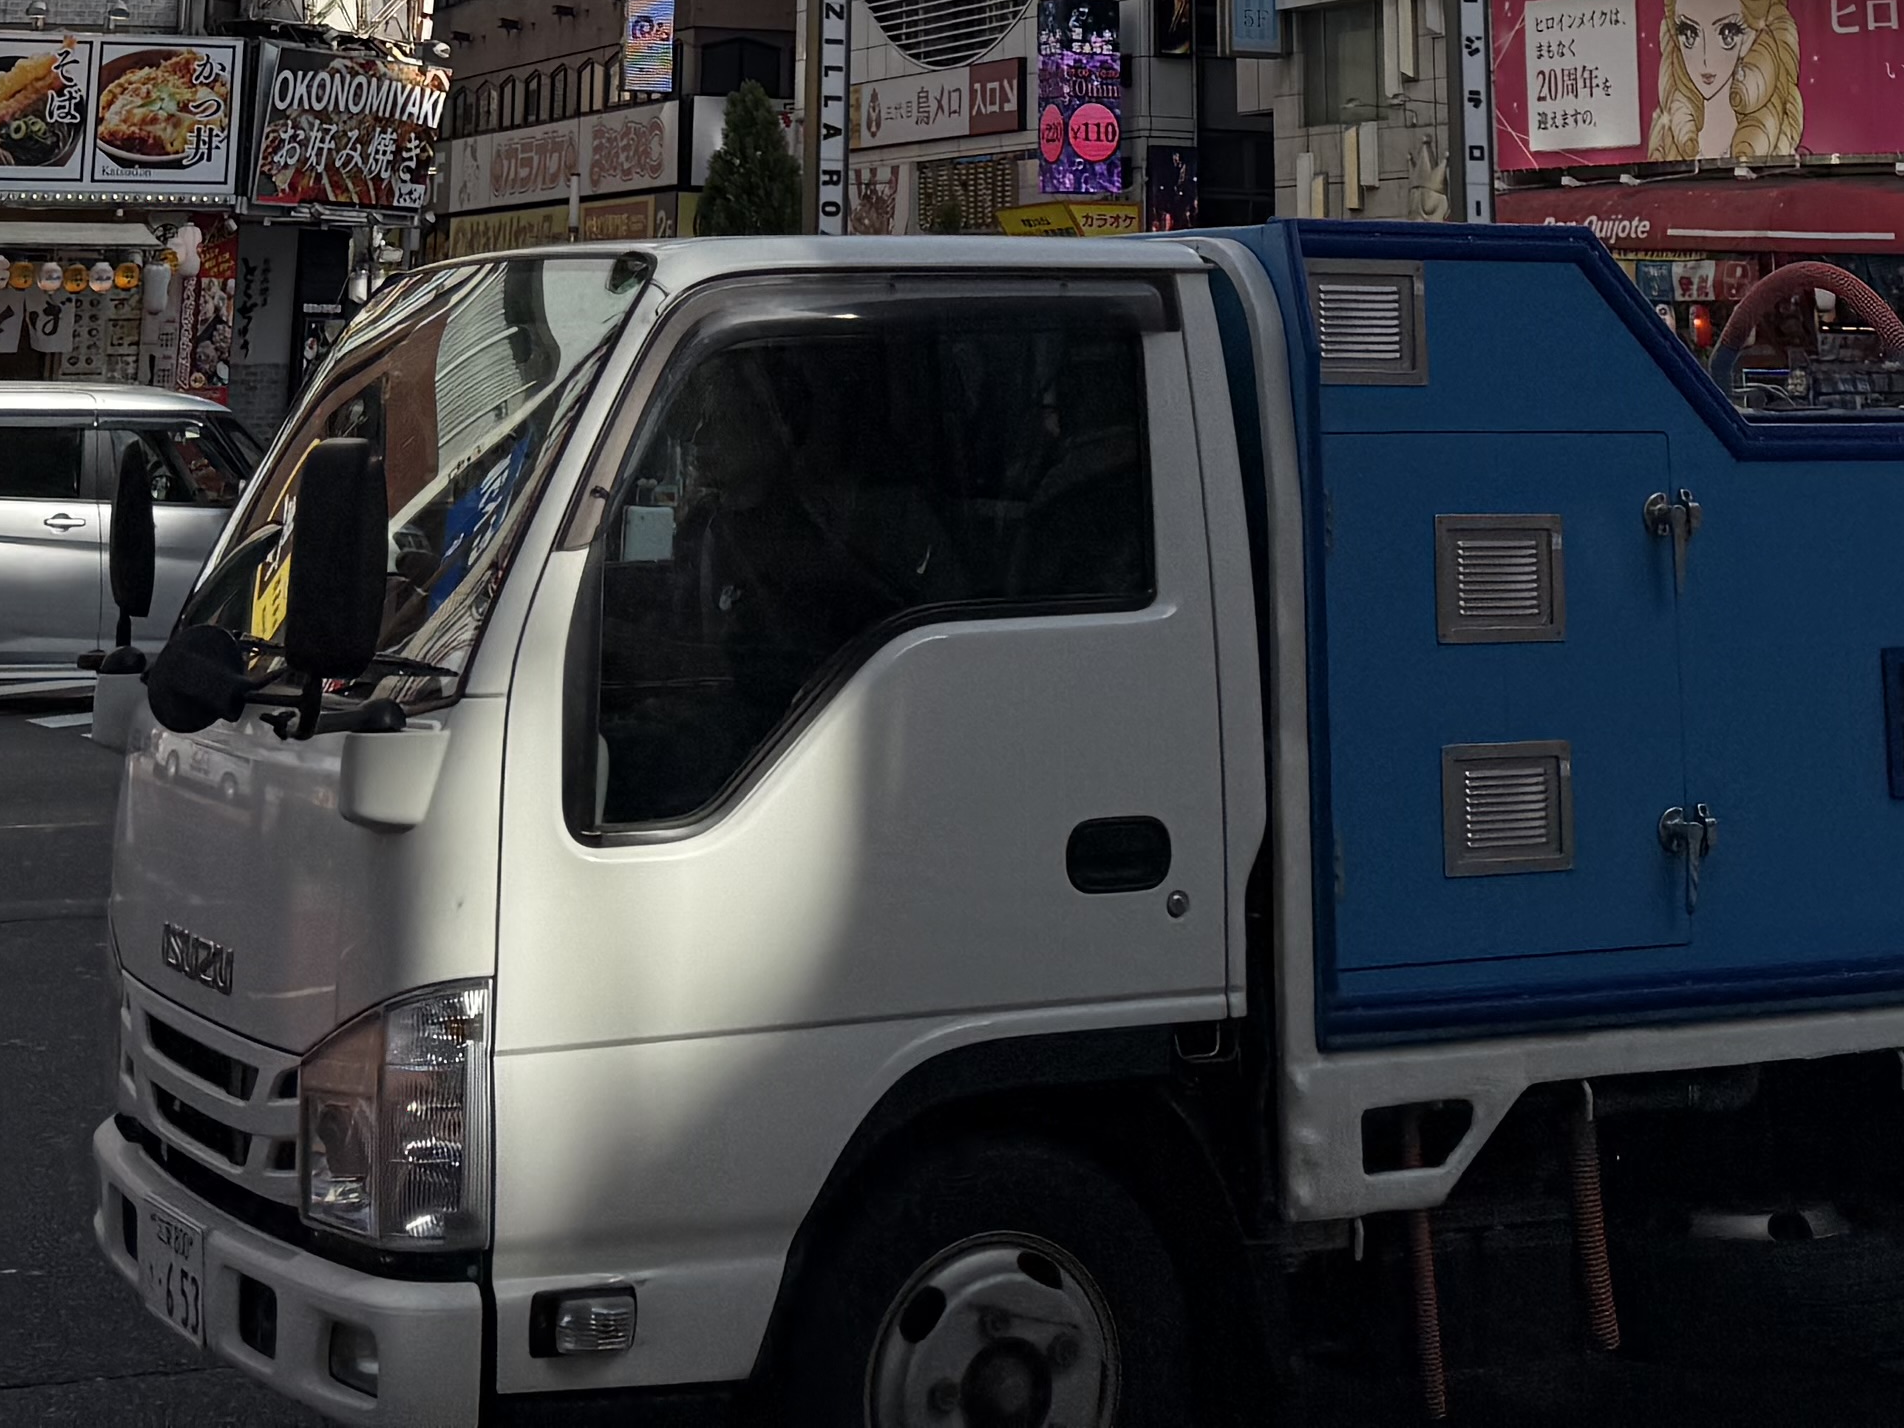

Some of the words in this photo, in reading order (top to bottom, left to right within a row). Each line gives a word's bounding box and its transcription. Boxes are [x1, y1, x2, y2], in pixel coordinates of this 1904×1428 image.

[1242, 9, 1269, 29] 5F
[1534, 7, 1627, 34] ヒロインメイクは、
[1534, 38, 1578, 60] まもなく
[44, 48, 84, 125] そば
[272, 67, 446, 130] OKONOMIYAKI
[1535, 64, 1614, 102] 20周年を
[184, 52, 230, 165] かつ丼
[882, 84, 963, 127] 三代目鳥メロ
[274, 119, 425, 186] お好み焼き
[1080, 210, 1137, 231] カラオケ
[1583, 213, 1652, 244] Quijote
[161, 921, 235, 996] ISUZU
